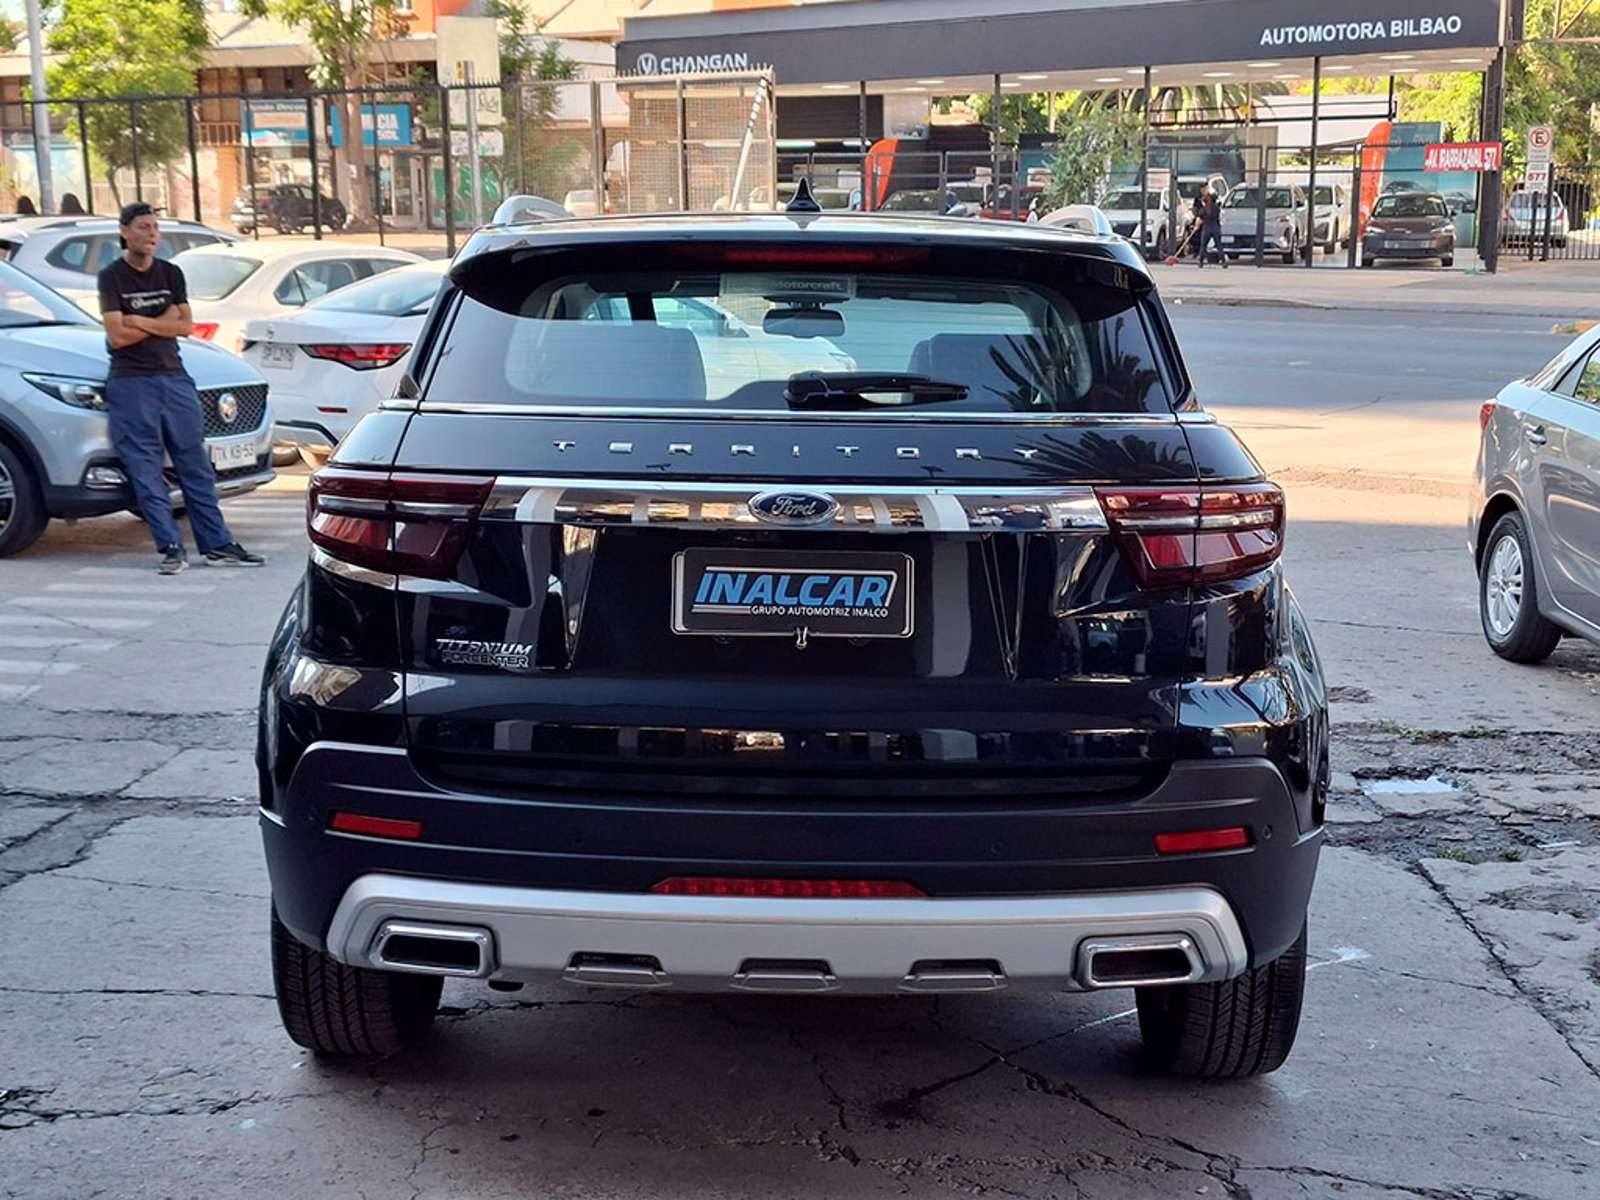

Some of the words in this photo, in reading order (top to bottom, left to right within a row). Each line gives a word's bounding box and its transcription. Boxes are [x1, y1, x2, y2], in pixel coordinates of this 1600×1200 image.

[1260, 21, 1386, 45] AUTOMOTORA
[1390, 15, 1462, 37] BILBAO
[661, 53, 747, 72] CHANGAN
[1528, 172, 1547, 181] 577
[553, 439, 1038, 460] TERRITORY
[771, 497, 817, 515] Ford
[695, 572, 890, 607] INALCAR
[752, 605, 786, 615] GRUPO
[788, 607, 850, 616] AUTOMOTRIZ
[852, 608, 889, 617] INALCO
[436, 639, 533, 655] TITANIUM
